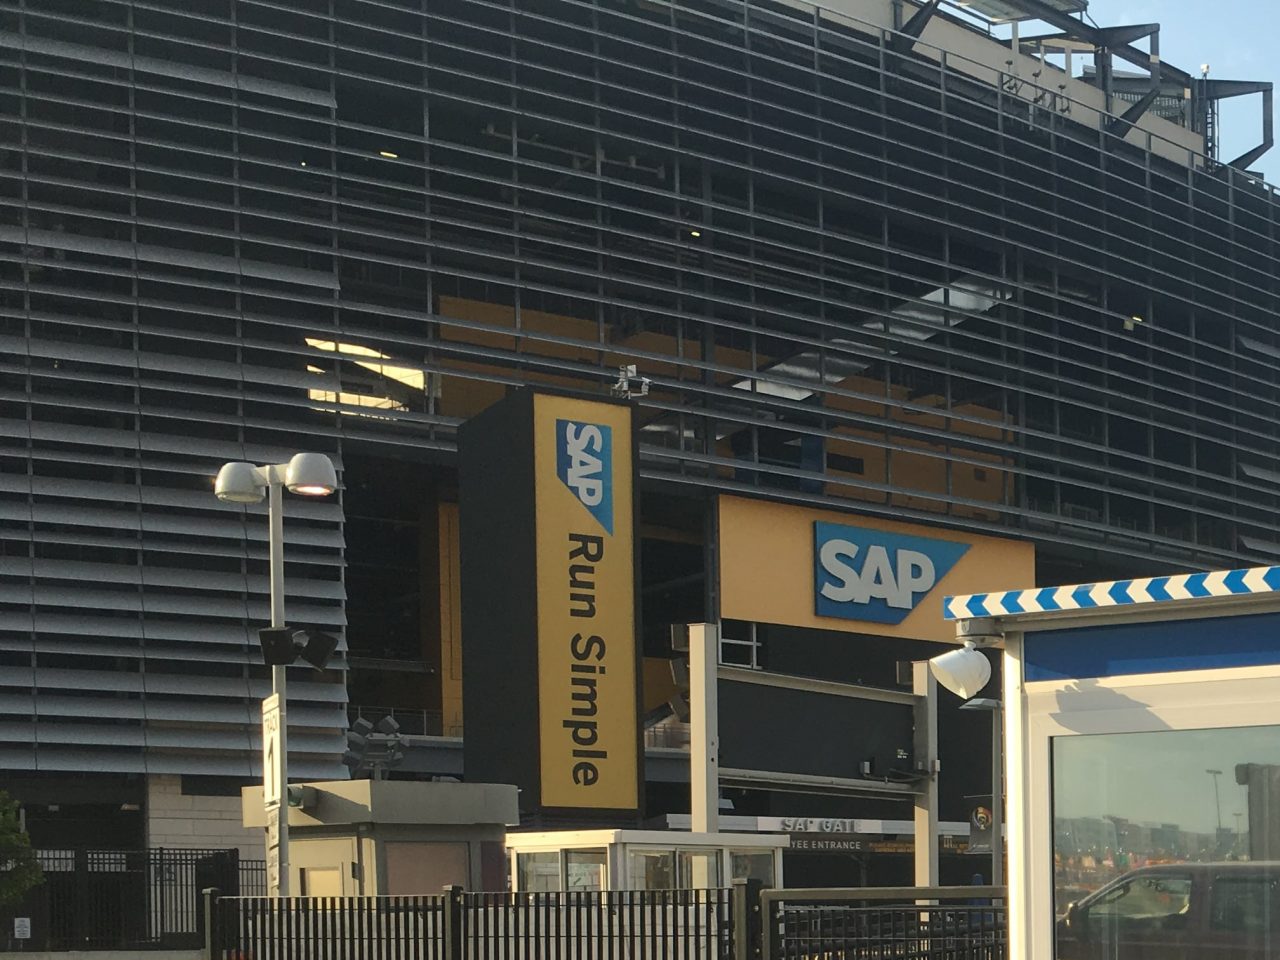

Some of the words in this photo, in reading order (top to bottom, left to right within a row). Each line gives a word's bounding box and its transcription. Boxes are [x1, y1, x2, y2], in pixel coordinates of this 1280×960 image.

[566, 422, 603, 507] SAP
[568, 532, 604, 619] Run
[819, 538, 936, 610] SAP
[562, 632, 608, 787] Simple
[791, 840, 809, 849] YEE
[812, 841, 861, 850] ENTRANCE
